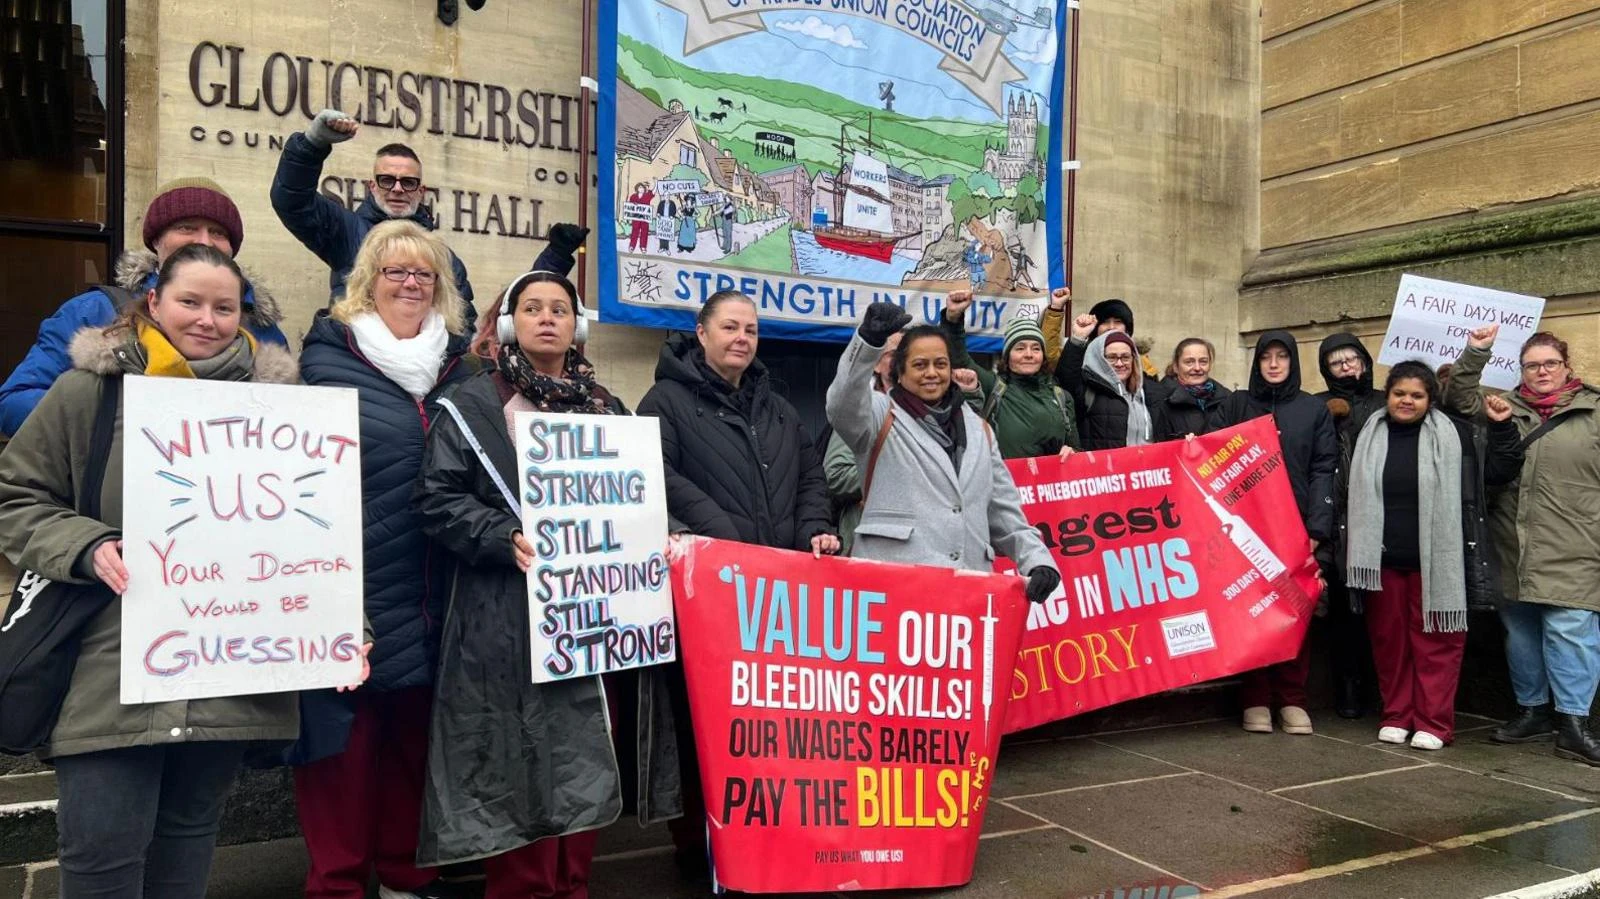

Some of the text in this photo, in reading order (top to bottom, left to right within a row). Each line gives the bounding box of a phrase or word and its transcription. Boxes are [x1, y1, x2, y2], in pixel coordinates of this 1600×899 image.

[895, 4, 976, 62] COUNCILS
[903, 0, 987, 45] CIATION
[190, 126, 283, 151] COUN
[854, 169, 887, 183] WORKERS
[452, 190, 552, 240] HALL
[857, 204, 878, 216] UNITE
[922, 296, 1007, 329] UITY
[1403, 293, 1416, 308] A
[1422, 296, 1456, 315] FAIR
[1500, 311, 1535, 330] WAGE
[1389, 336, 1400, 349] A
[1405, 337, 1434, 353] FAIR
[1487, 355, 1515, 372] ORK
[141, 417, 358, 465] WITHOUT
[526, 418, 620, 463] STILL
[1197, 463, 1213, 479] NO
[1208, 447, 1231, 469] FAIR
[1209, 476, 1227, 493] NO
[1221, 461, 1245, 483] FAIR
[207, 473, 286, 521] US
[524, 466, 645, 508] STRIKING
[1037, 473, 1126, 503] PHLEBOTOMIST
[1130, 468, 1172, 490] STRIKE
[1223, 486, 1244, 506] ONE
[1239, 467, 1266, 493] MORE
[535, 518, 624, 561] STILL
[1030, 493, 1181, 557] ngest
[149, 538, 353, 586] YOUR DOCTOR
[535, 552, 668, 603] STANDING
[1073, 574, 1105, 619] IN
[1102, 537, 1200, 613] NHS
[181, 595, 309, 618] WOULD BE
[1222, 569, 1260, 601] 300 DAYS
[1260, 590, 1280, 609] DAYS
[539, 598, 619, 638] STILL
[734, 573, 973, 670] VALUE OUR
[1167, 622, 1206, 640] UNISON
[143, 629, 360, 677] GUESSING
[543, 618, 675, 679] STRONG
[1008, 623, 1152, 701] STORY.
[731, 660, 972, 720] BLEEDING SKILLS!
[728, 717, 970, 765] OUR WAGES BARELY
[722, 767, 970, 828] PAY THE BILLS!
[815, 850, 829, 864] PAY
[830, 849, 839, 863] US
[860, 849, 874, 863] YOU
